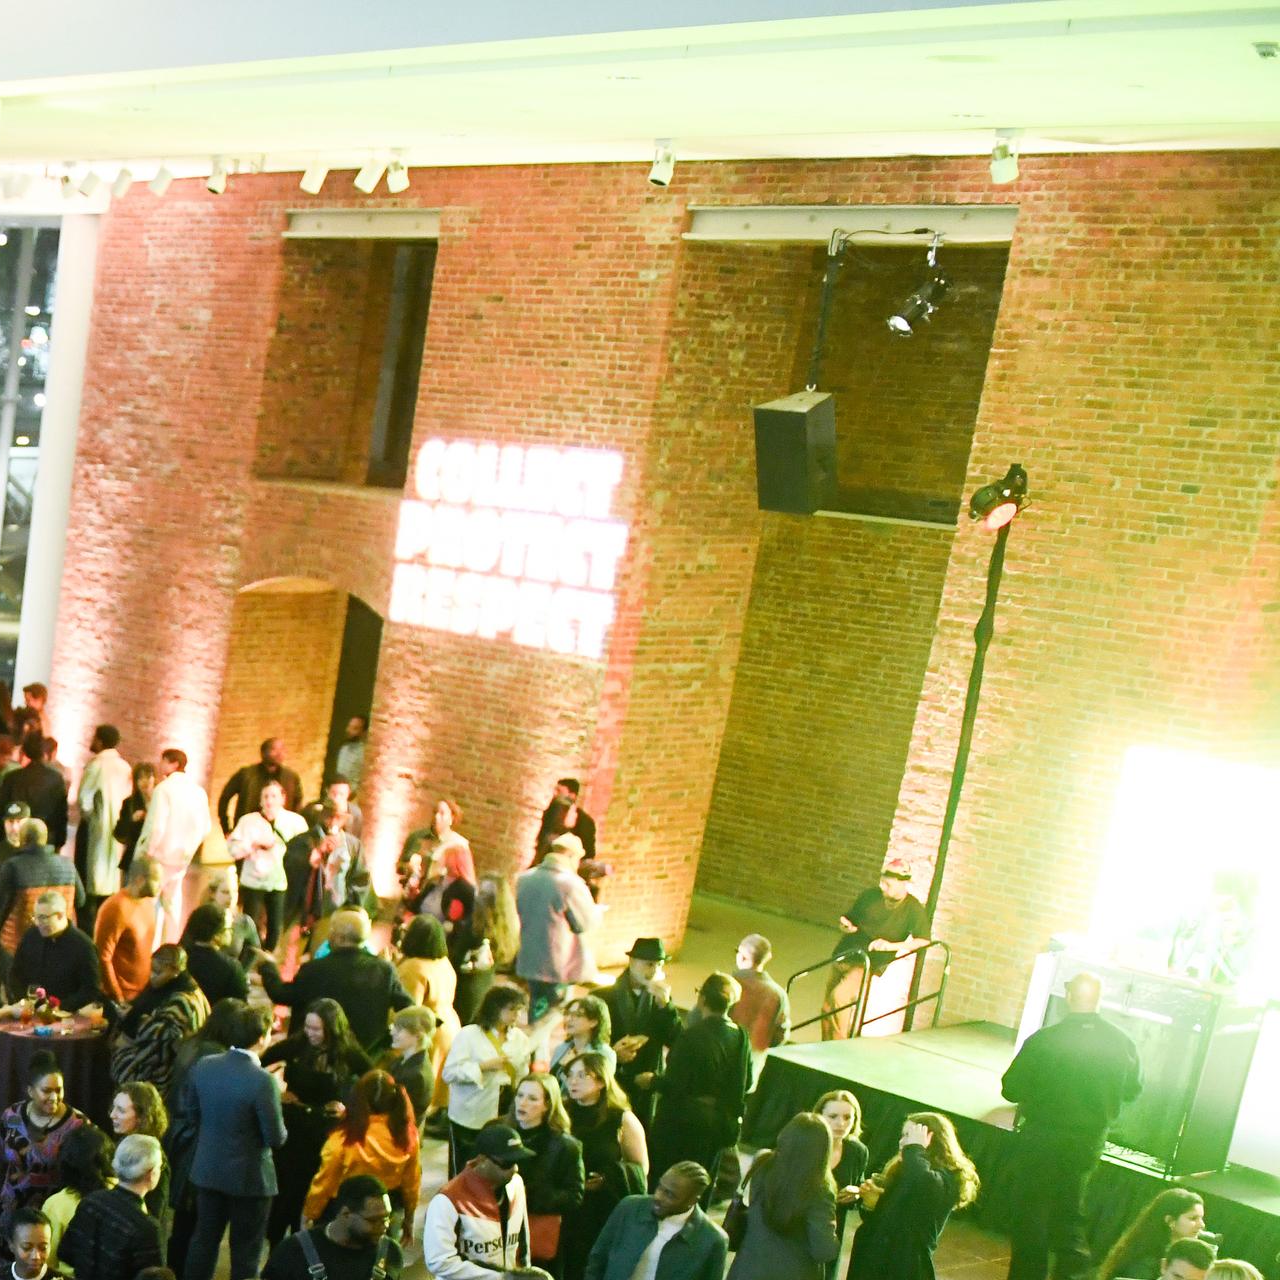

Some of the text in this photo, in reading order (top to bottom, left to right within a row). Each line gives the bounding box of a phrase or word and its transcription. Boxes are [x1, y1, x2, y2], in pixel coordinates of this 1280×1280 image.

[415, 439, 625, 518] COLLECT
[395, 499, 629, 589] PROTECT
[389, 563, 616, 659] RESPECT
